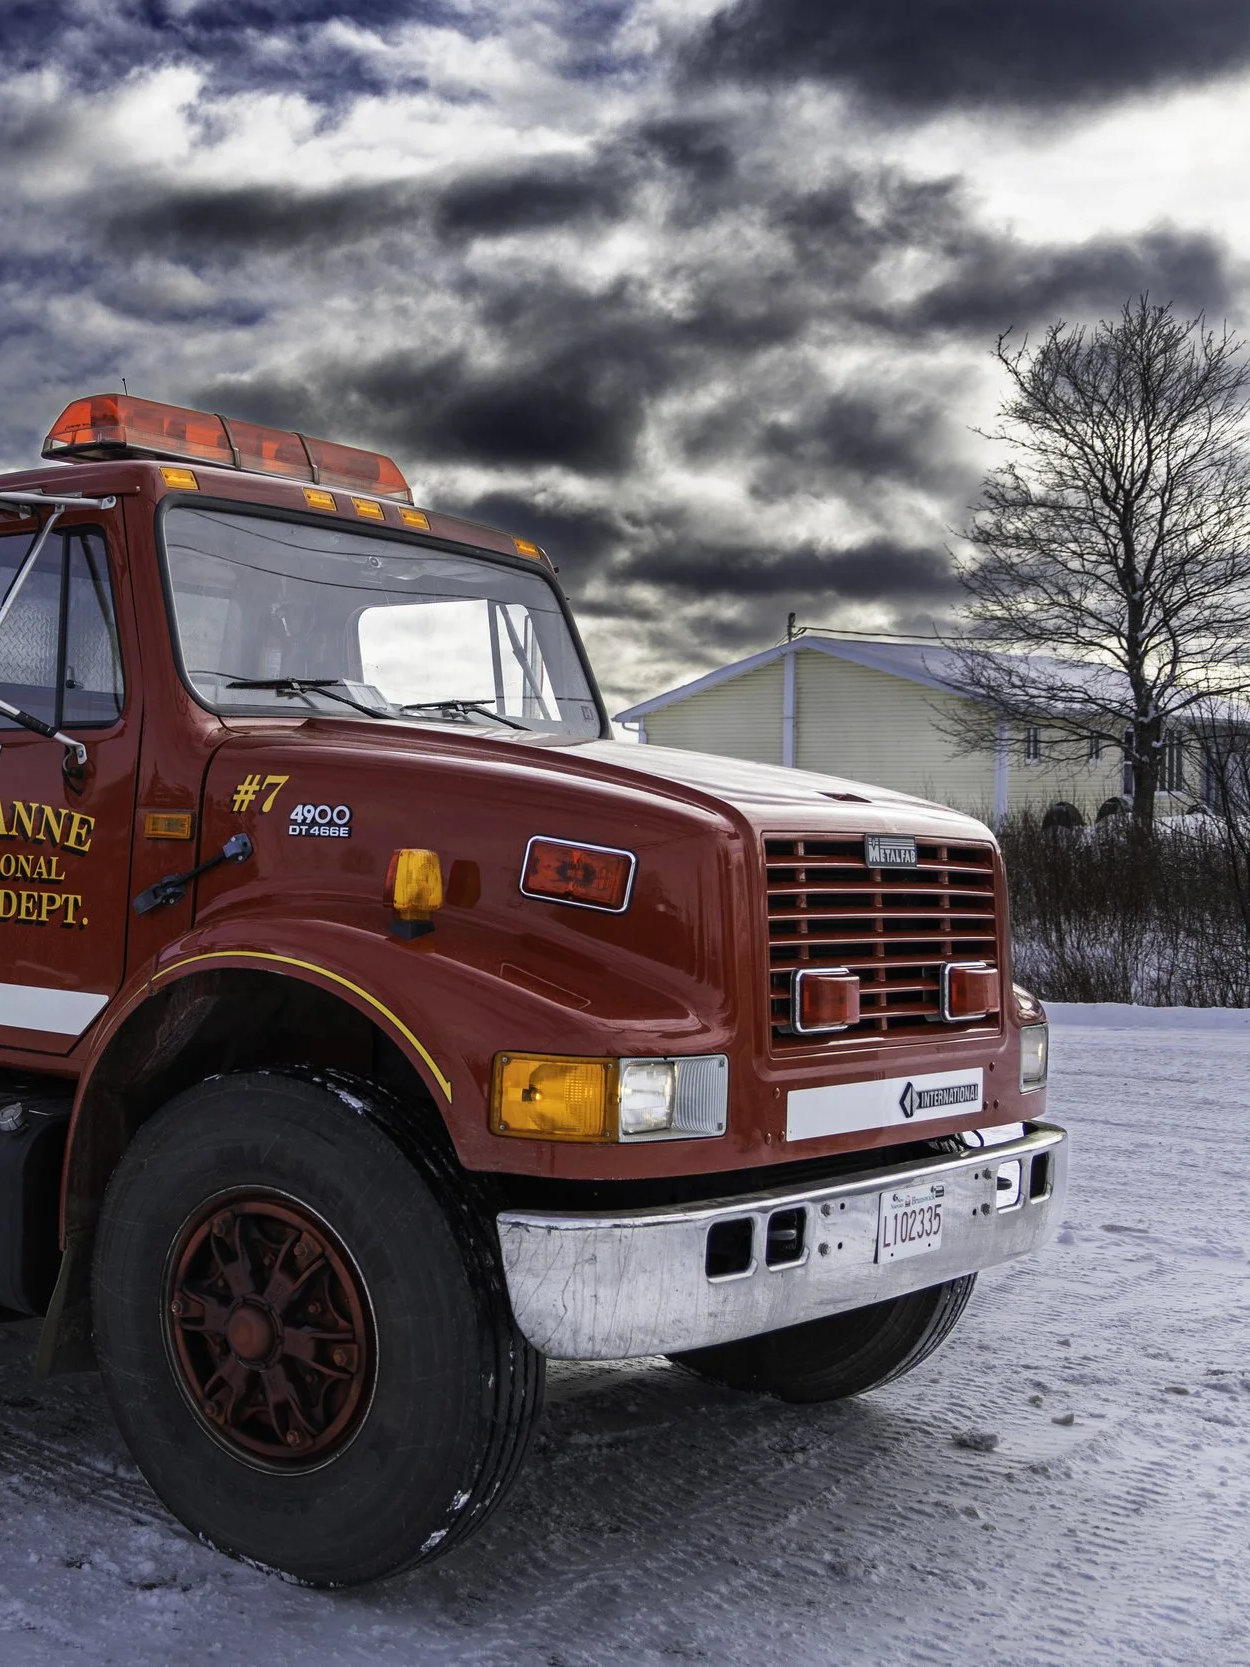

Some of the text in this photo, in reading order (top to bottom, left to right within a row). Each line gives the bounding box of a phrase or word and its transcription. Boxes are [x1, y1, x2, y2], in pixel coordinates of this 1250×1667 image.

[232, 774, 291, 813] #7
[289, 804, 350, 825] 4900
[921, 1085, 978, 1108] INTERNATIONAL
[883, 1203, 942, 1248] L102335
